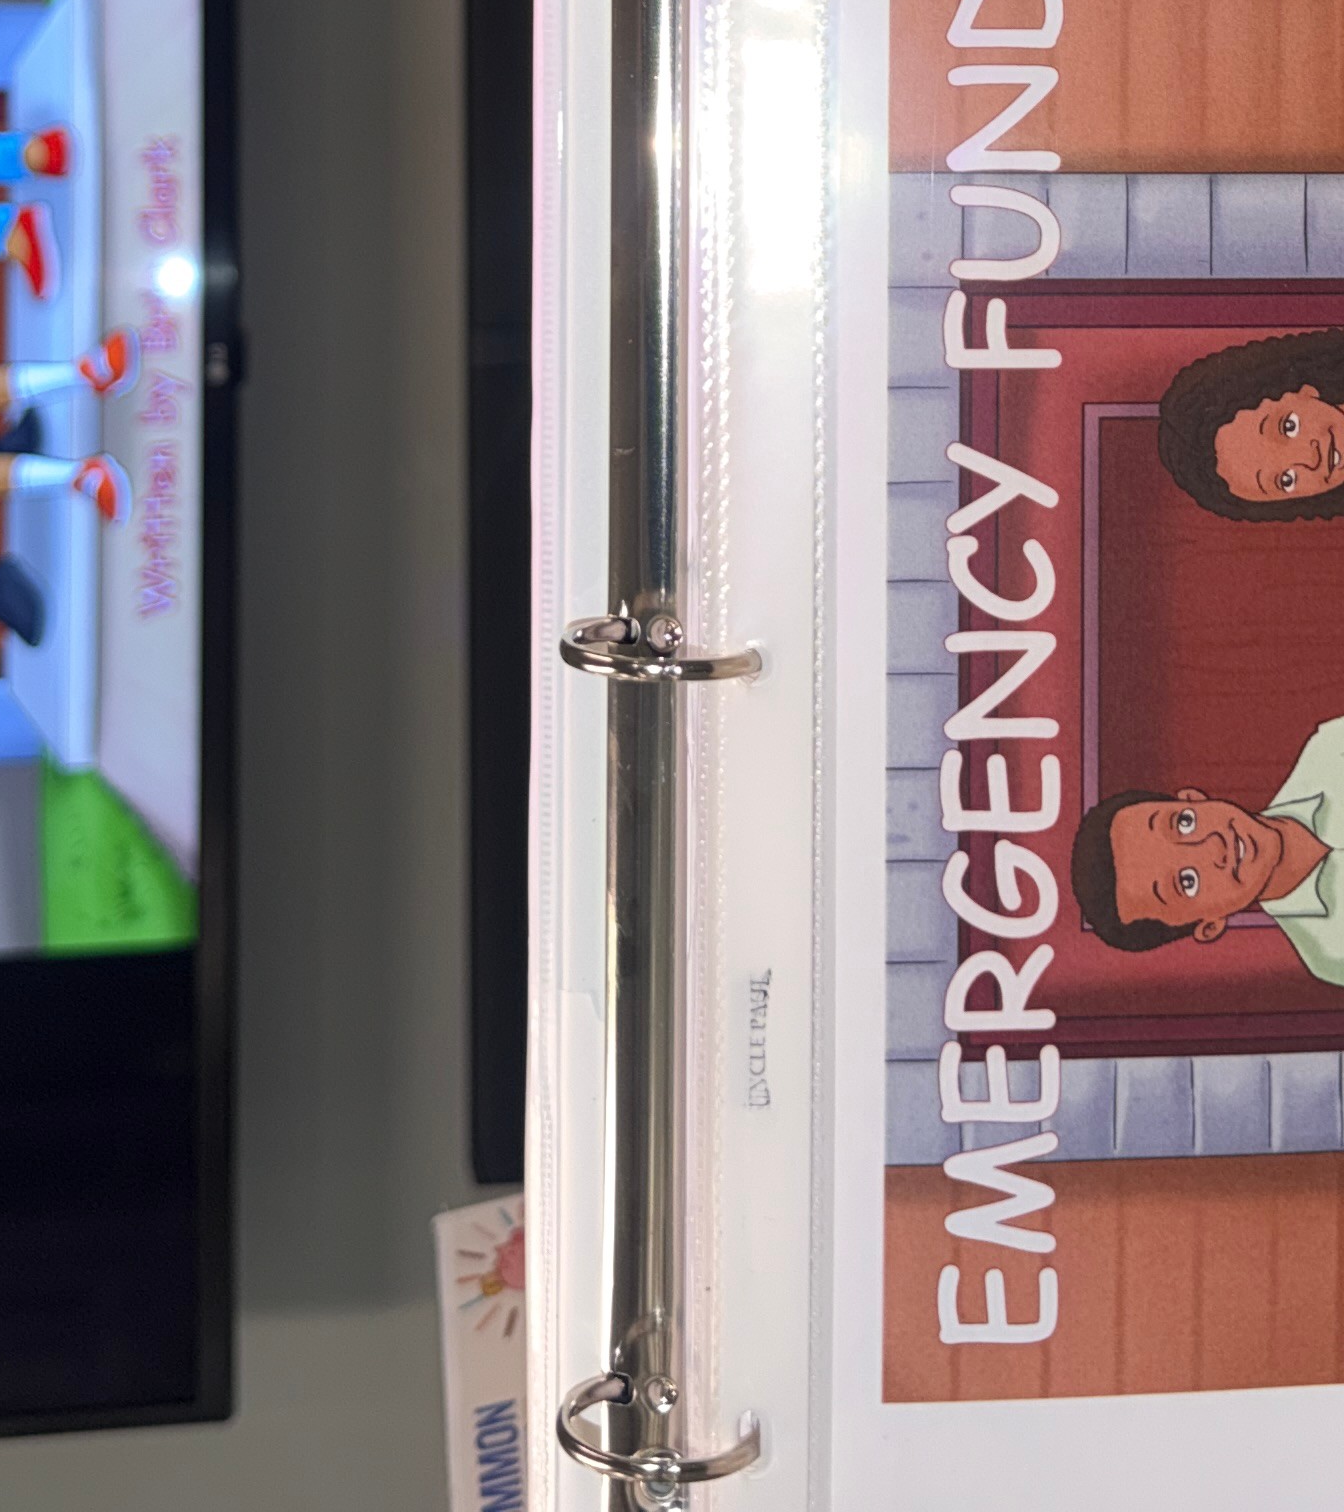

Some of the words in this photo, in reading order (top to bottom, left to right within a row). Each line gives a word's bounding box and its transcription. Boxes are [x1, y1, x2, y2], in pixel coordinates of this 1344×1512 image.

[135, 135, 183, 247] Clark
[136, 272, 182, 353] Br
[138, 372, 194, 426] by
[937, 441, 1060, 1346] EMERGENCY
[747, 1037, 771, 1108] UNCLE
